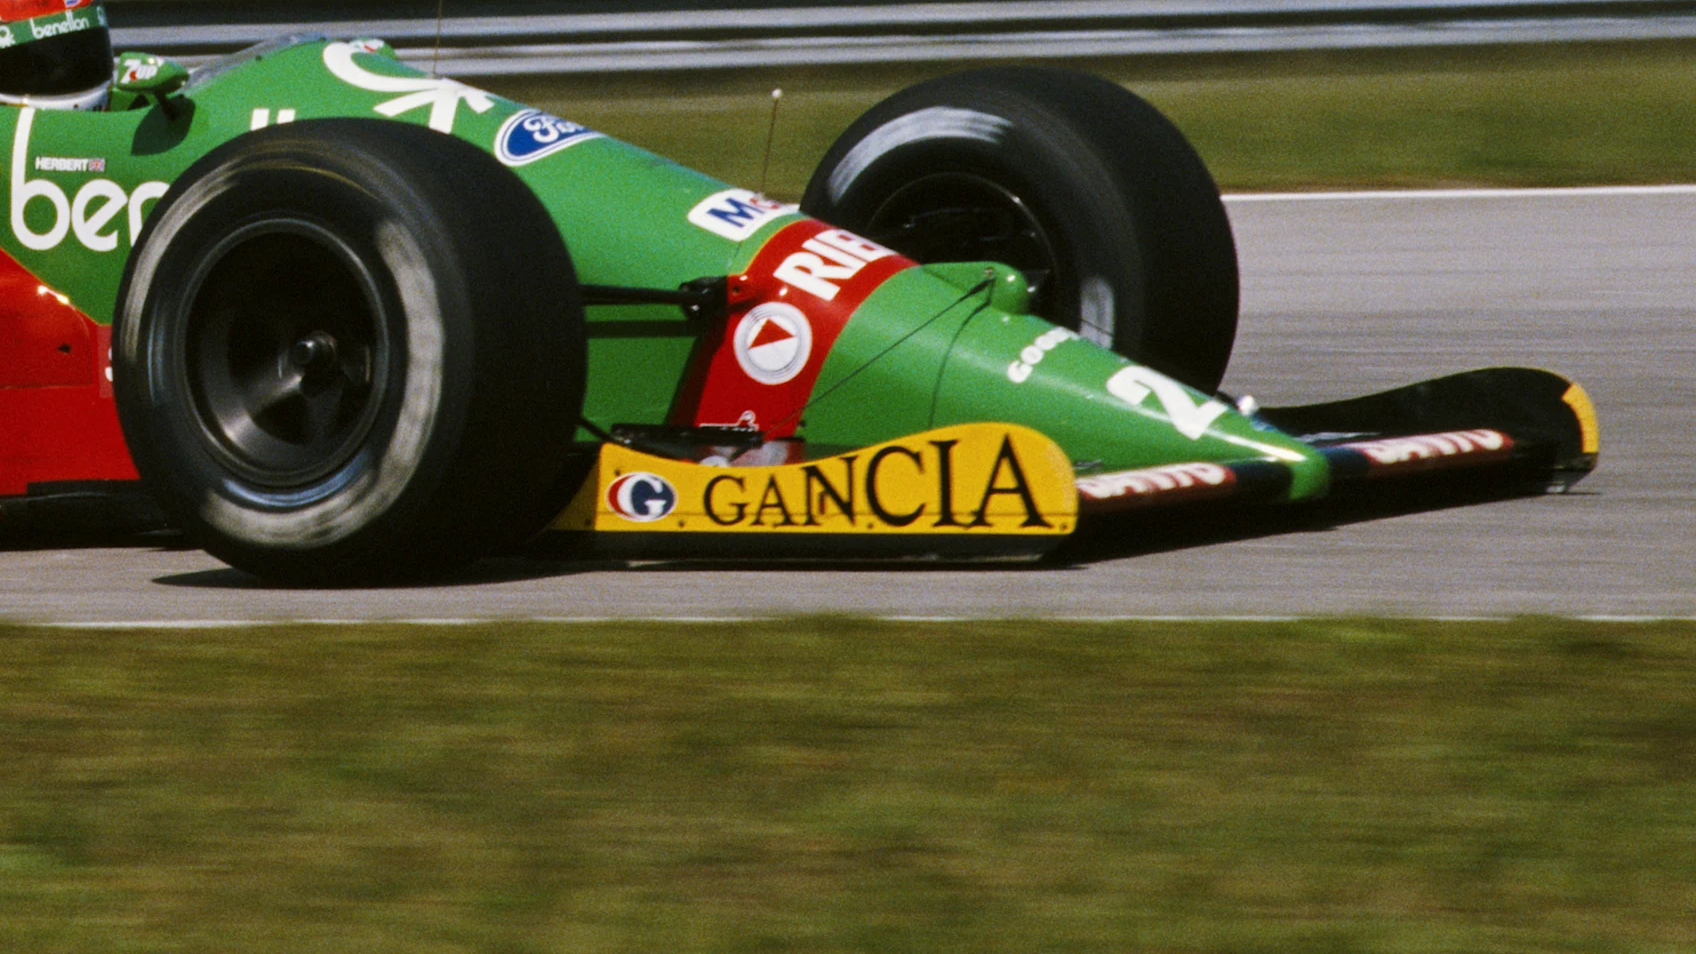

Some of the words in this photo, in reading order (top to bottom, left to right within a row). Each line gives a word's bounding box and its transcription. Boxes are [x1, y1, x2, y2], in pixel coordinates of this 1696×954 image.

[35, 156, 89, 171] HERBERT
[1106, 365, 1229, 441] 2
[703, 434, 1052, 530] GANCIA
